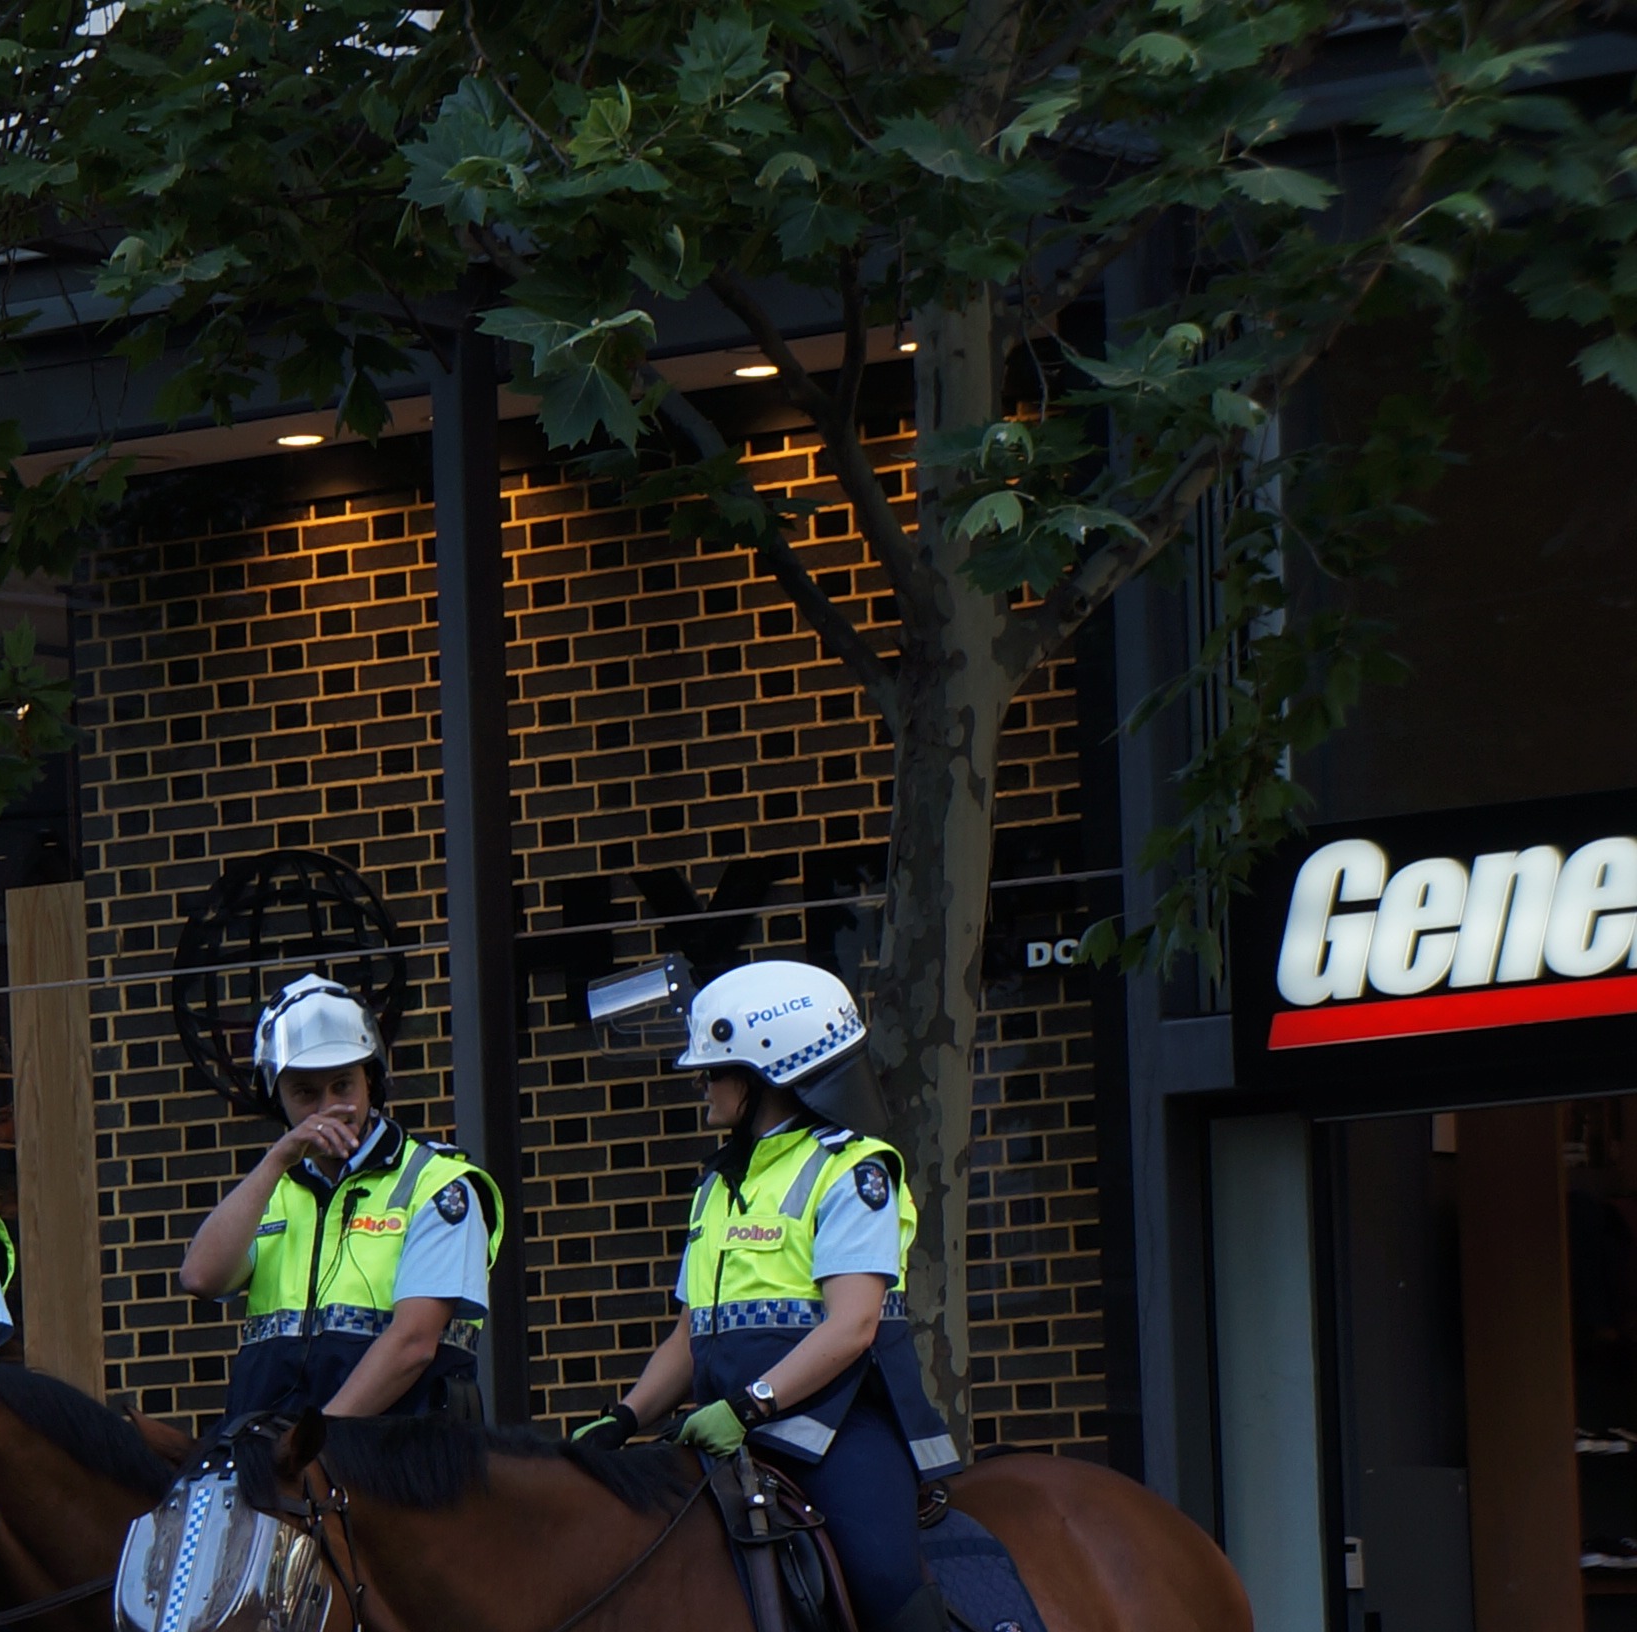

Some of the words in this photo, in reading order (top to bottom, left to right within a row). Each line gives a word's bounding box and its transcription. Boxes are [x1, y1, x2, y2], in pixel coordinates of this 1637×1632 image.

[1276, 836, 1637, 1007] Gene
[1026, 938, 1079, 968] DC
[746, 996, 813, 1029] POLICE
[349, 1216, 401, 1232] olice
